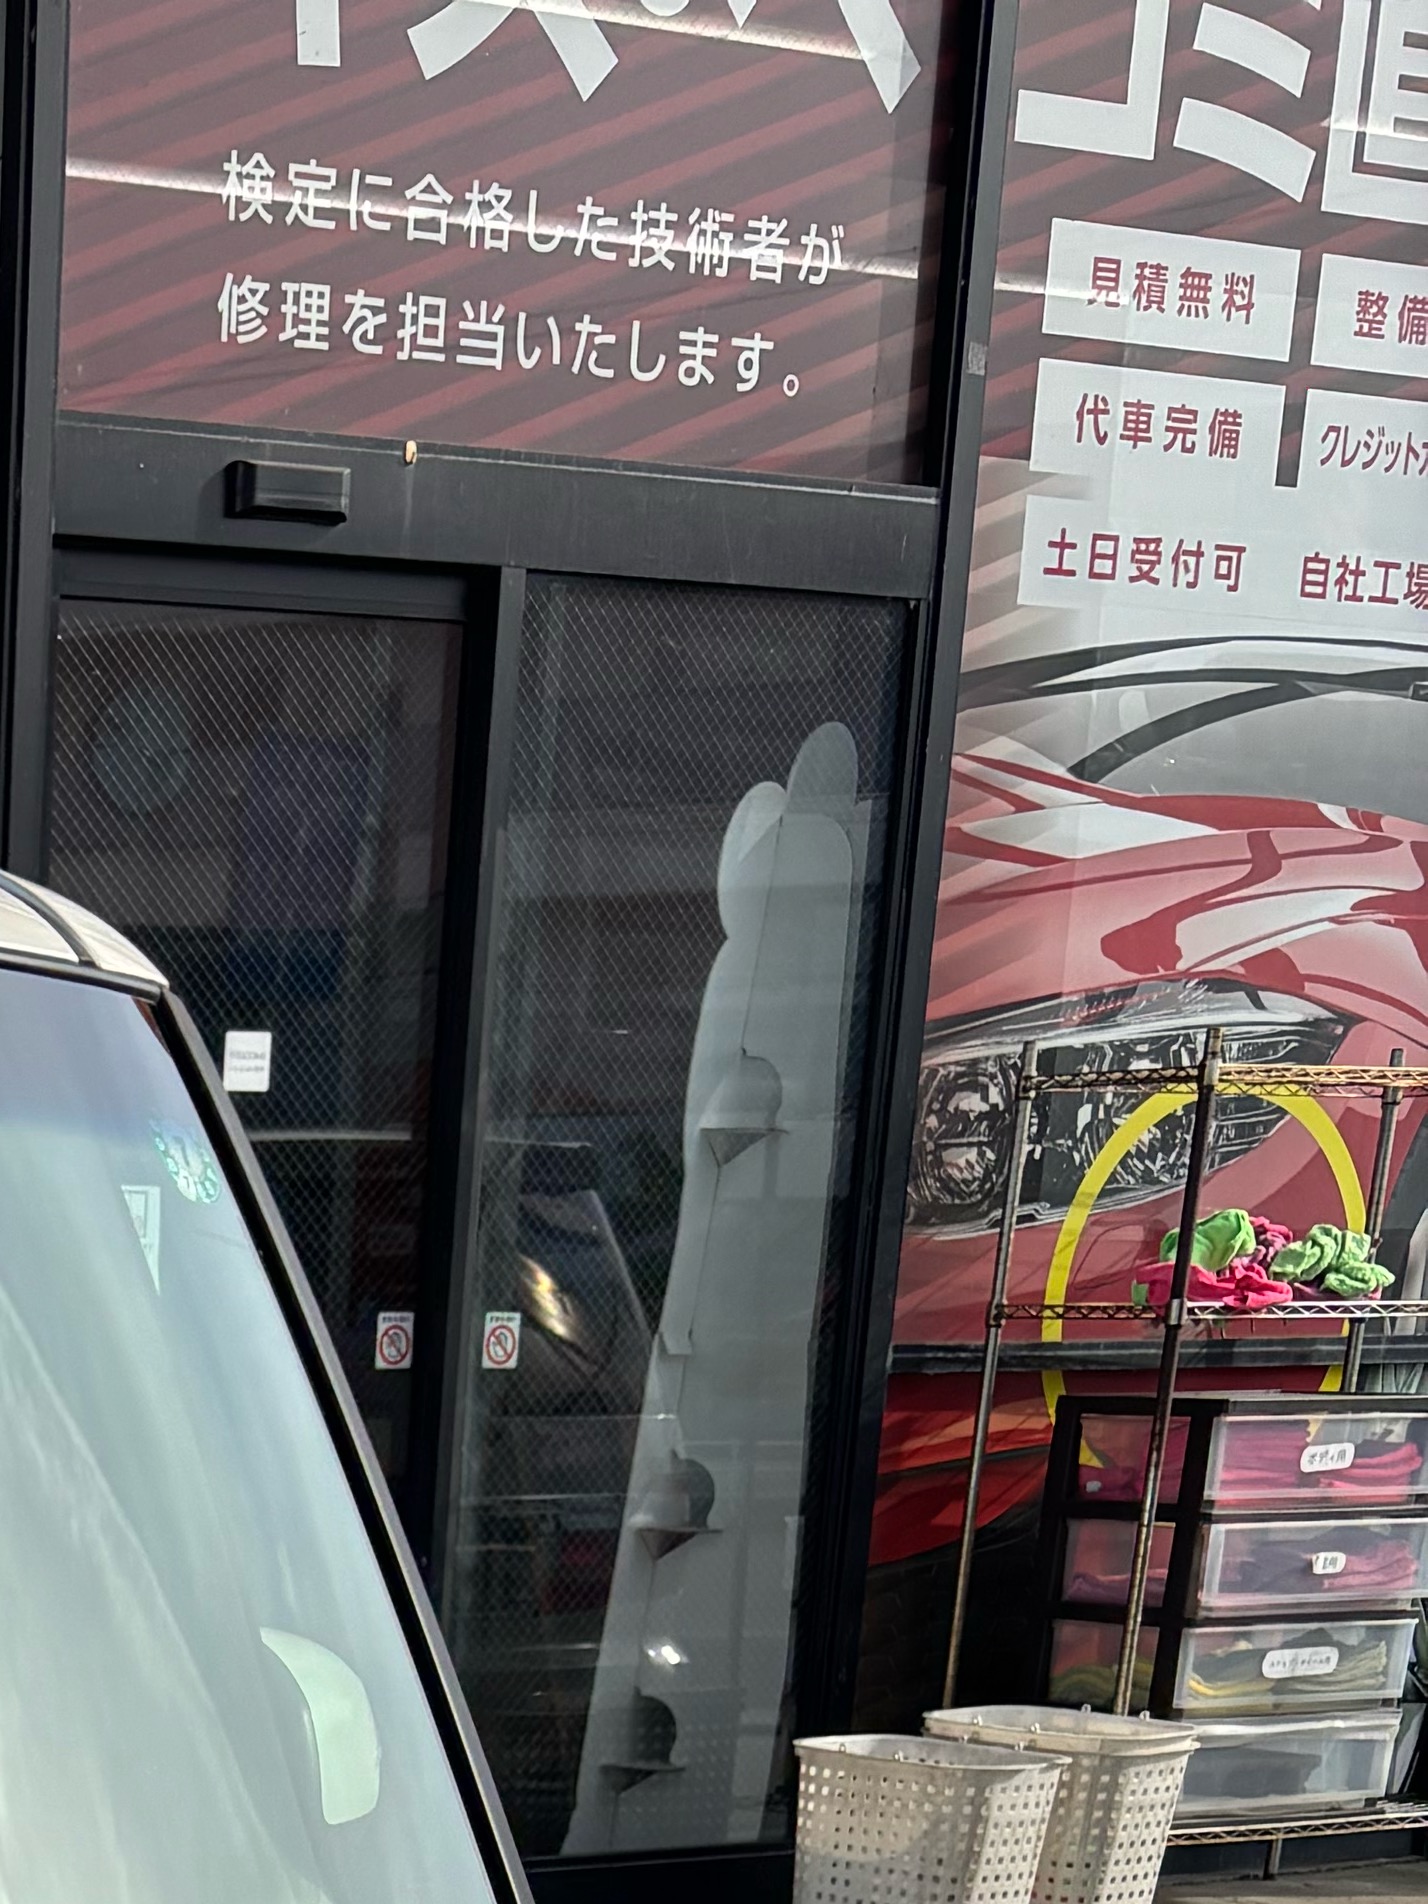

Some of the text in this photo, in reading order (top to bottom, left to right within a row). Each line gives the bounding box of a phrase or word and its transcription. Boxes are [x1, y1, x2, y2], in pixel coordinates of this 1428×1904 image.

[220, 149, 845, 285] 検定に合格した技術者が
[1087, 255, 1256, 325] 見積無料
[217, 272, 800, 398] 修理を担当いたします。
[1075, 392, 1243, 460] 代車完備
[1042, 527, 1247, 593] 土日受付可
